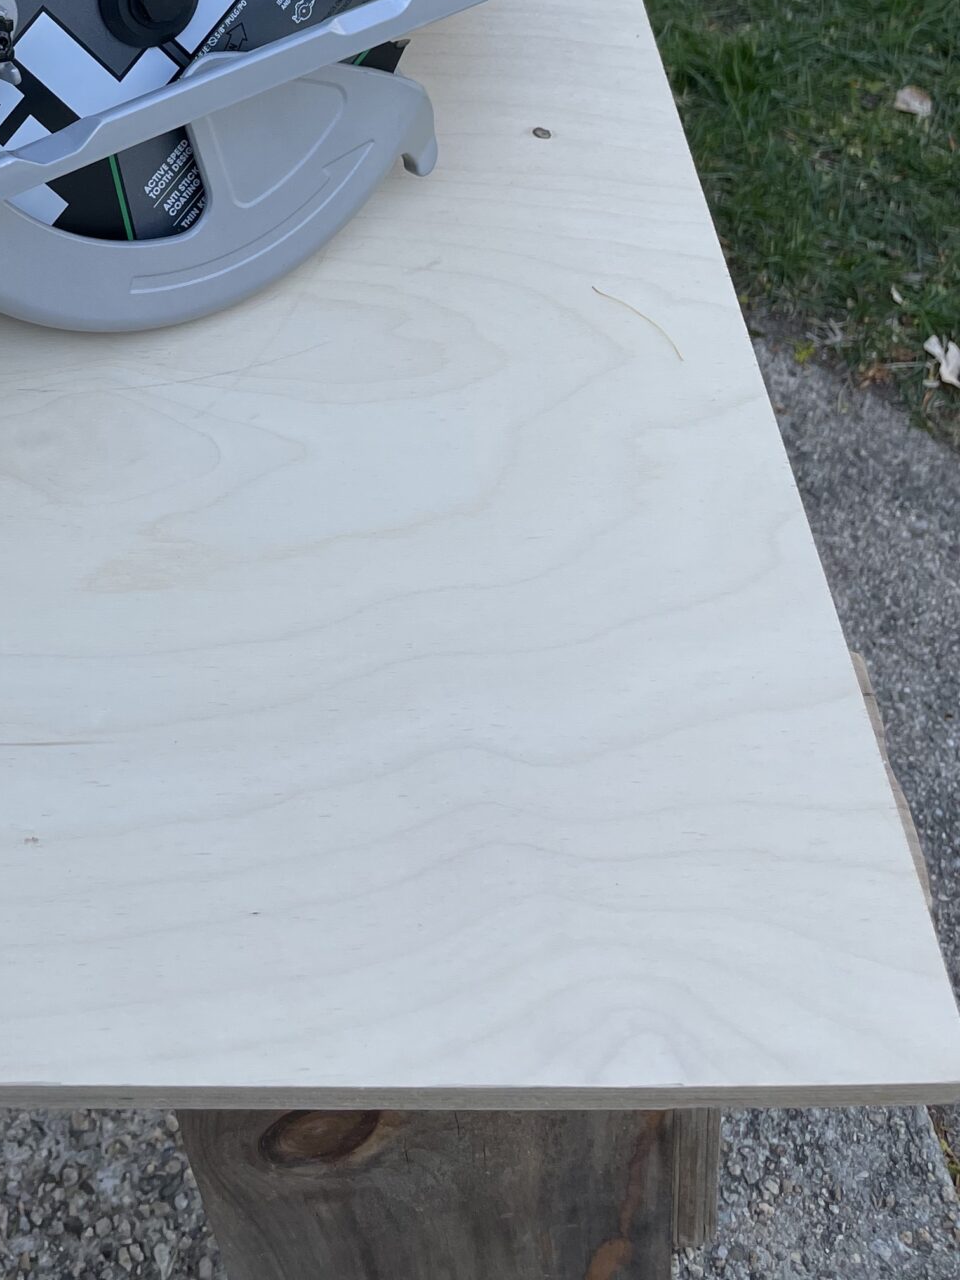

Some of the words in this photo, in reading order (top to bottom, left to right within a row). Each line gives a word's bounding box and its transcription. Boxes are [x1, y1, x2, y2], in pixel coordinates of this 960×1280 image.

[144, 163, 169, 194] ACTIVE
[166, 139, 188, 165] SPEED
[148, 170, 174, 199] TOOTH
[172, 147, 194, 172] DESIG
[163, 190, 181, 212] ANTI
[178, 166, 200, 192] STICK
[169, 179, 201, 216] COATING
[180, 208, 200, 228] THIN
